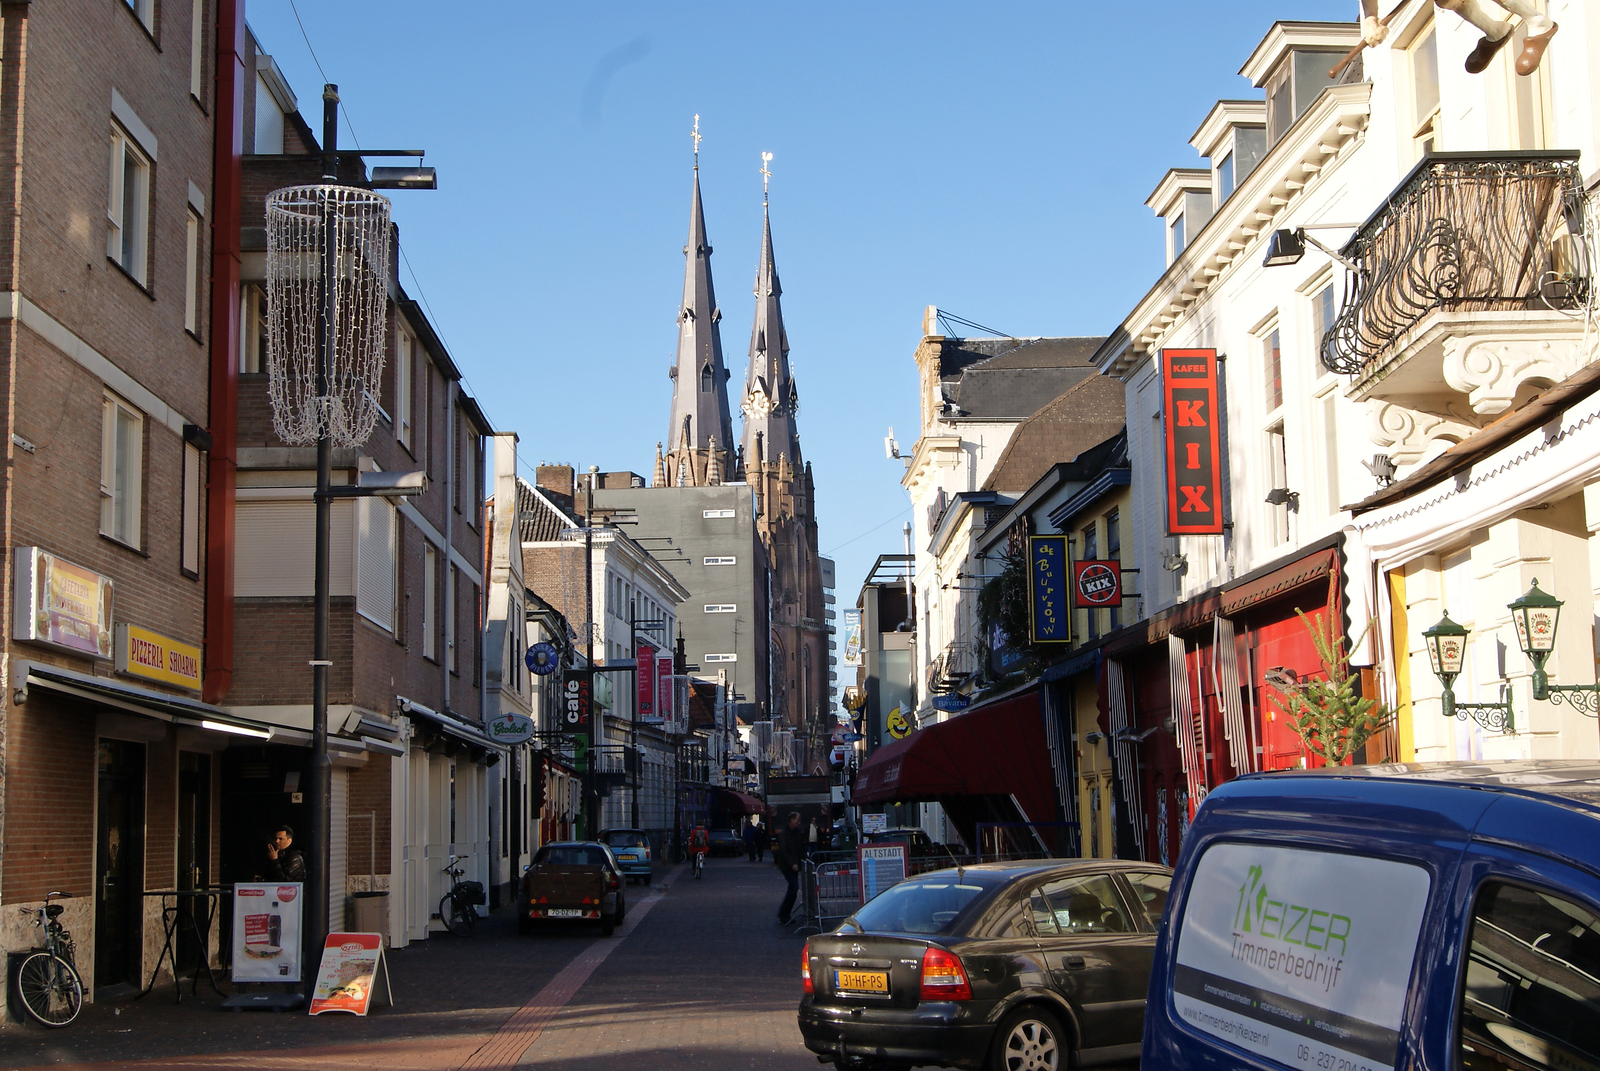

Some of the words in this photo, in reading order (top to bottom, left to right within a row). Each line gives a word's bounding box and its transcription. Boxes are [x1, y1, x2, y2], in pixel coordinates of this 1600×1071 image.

[1173, 365, 1206, 373] KAFEE
[1176, 400, 1211, 513] KIX
[1086, 577, 1112, 593] KIX
[131, 637, 164, 670] PIZZERIA
[169, 651, 198, 678] SHOARMA
[528, 643, 556, 657] BAVARIA
[529, 661, 554, 674] BIEREN
[563, 679, 580, 724] café
[938, 699, 967, 708] Bavaria
[493, 721, 528, 736] Grolsch
[864, 847, 902, 858] ALTSTADT
[1234, 864, 1352, 957] KEIZER
[1231, 932, 1343, 993] Timmerbedrijf
[843, 973, 883, 988] 31-HF-PS
[1183, 1005, 1270, 1047] www.timmerbedrijfkeizer.nl
[1314, 1019, 1351, 1039] verbouwingen
[1297, 1044, 1309, 1061] 06
[1317, 1051, 1336, 1070] 237
